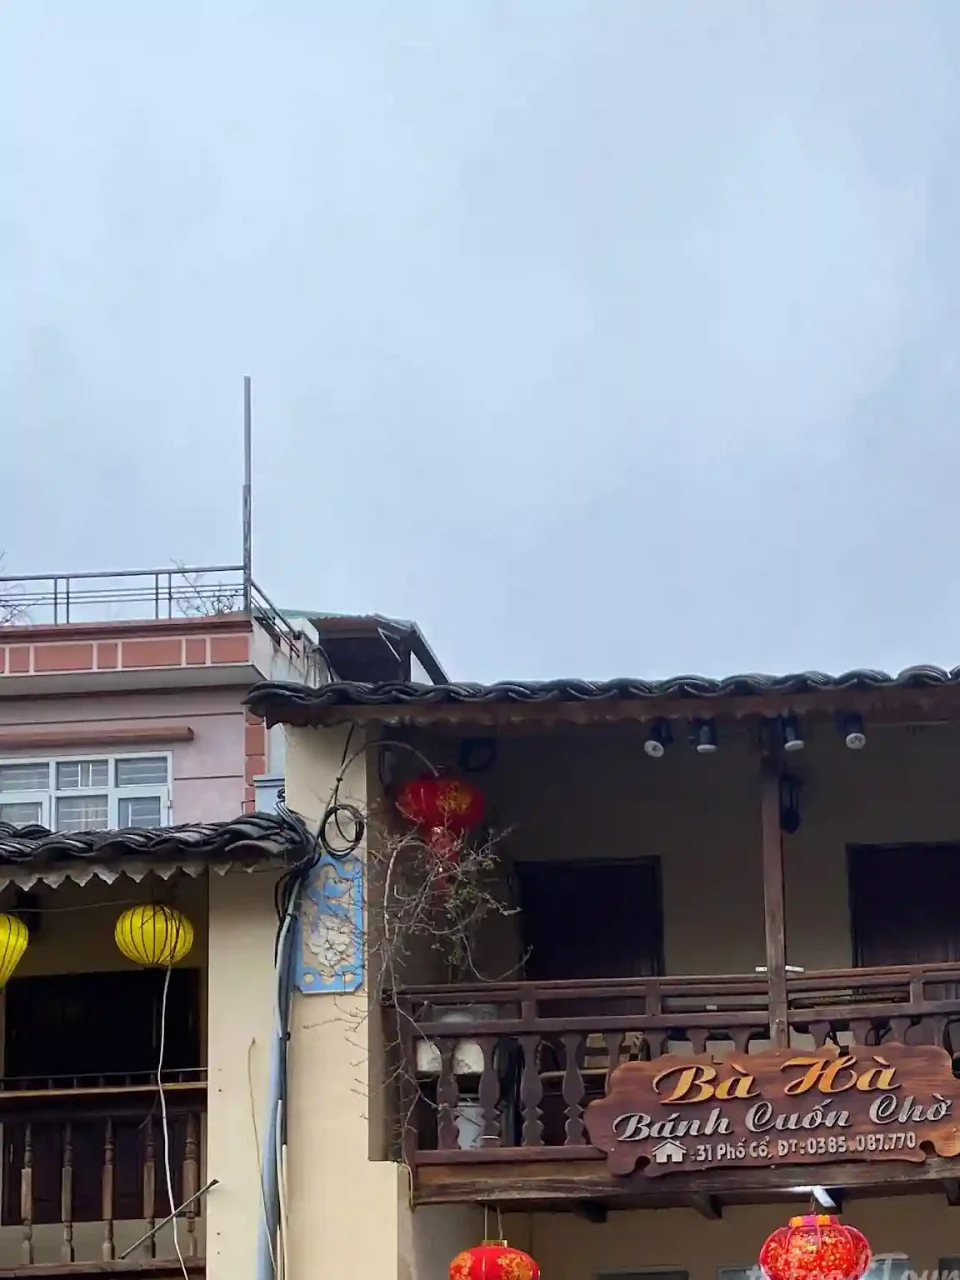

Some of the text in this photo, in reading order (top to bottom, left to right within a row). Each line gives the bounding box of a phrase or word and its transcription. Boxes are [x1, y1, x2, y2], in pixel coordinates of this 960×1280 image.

[653, 1055, 901, 1104] Bà Hà
[613, 1093, 951, 1141] Bánh Cuốn Chờ
[717, 1137, 746, 1160] Phố
